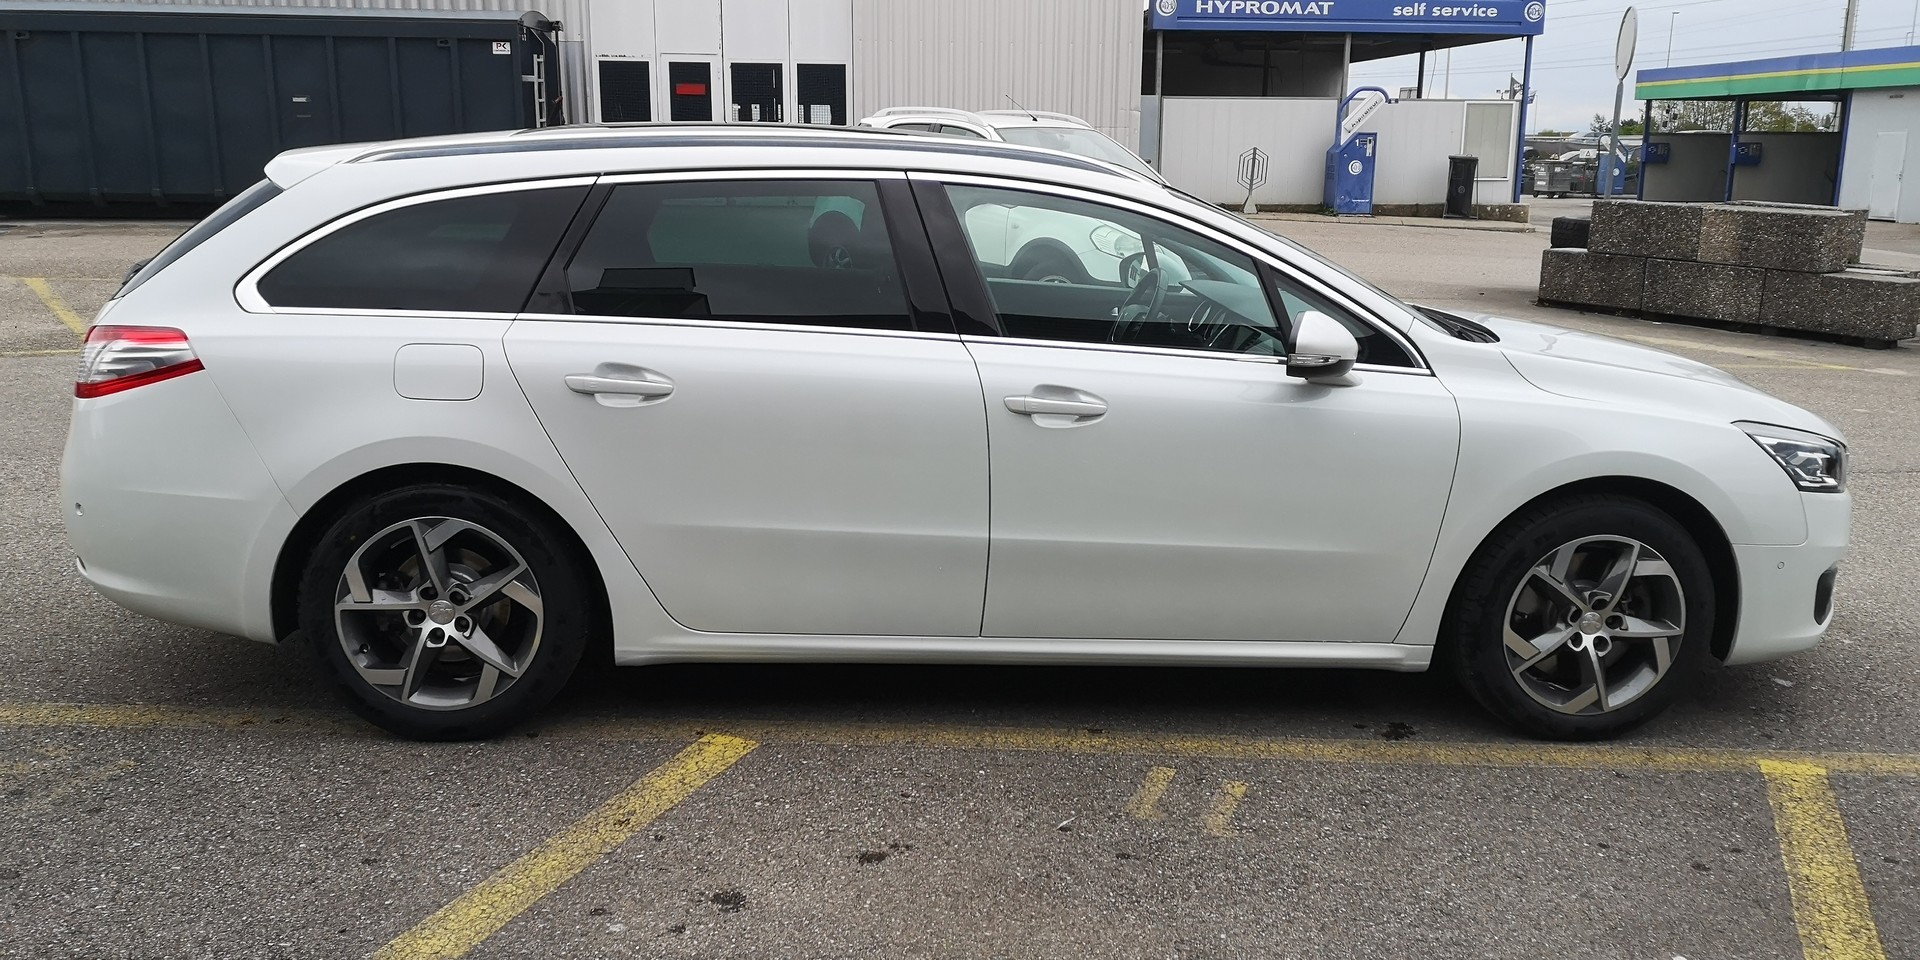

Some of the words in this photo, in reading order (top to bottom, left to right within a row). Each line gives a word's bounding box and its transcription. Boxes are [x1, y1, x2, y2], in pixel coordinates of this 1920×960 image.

[1195, 0, 1335, 15] HYPROMAT
[1393, 2, 1427, 17] self
[1432, 3, 1498, 17] service
[1355, 138, 1360, 147] 1
